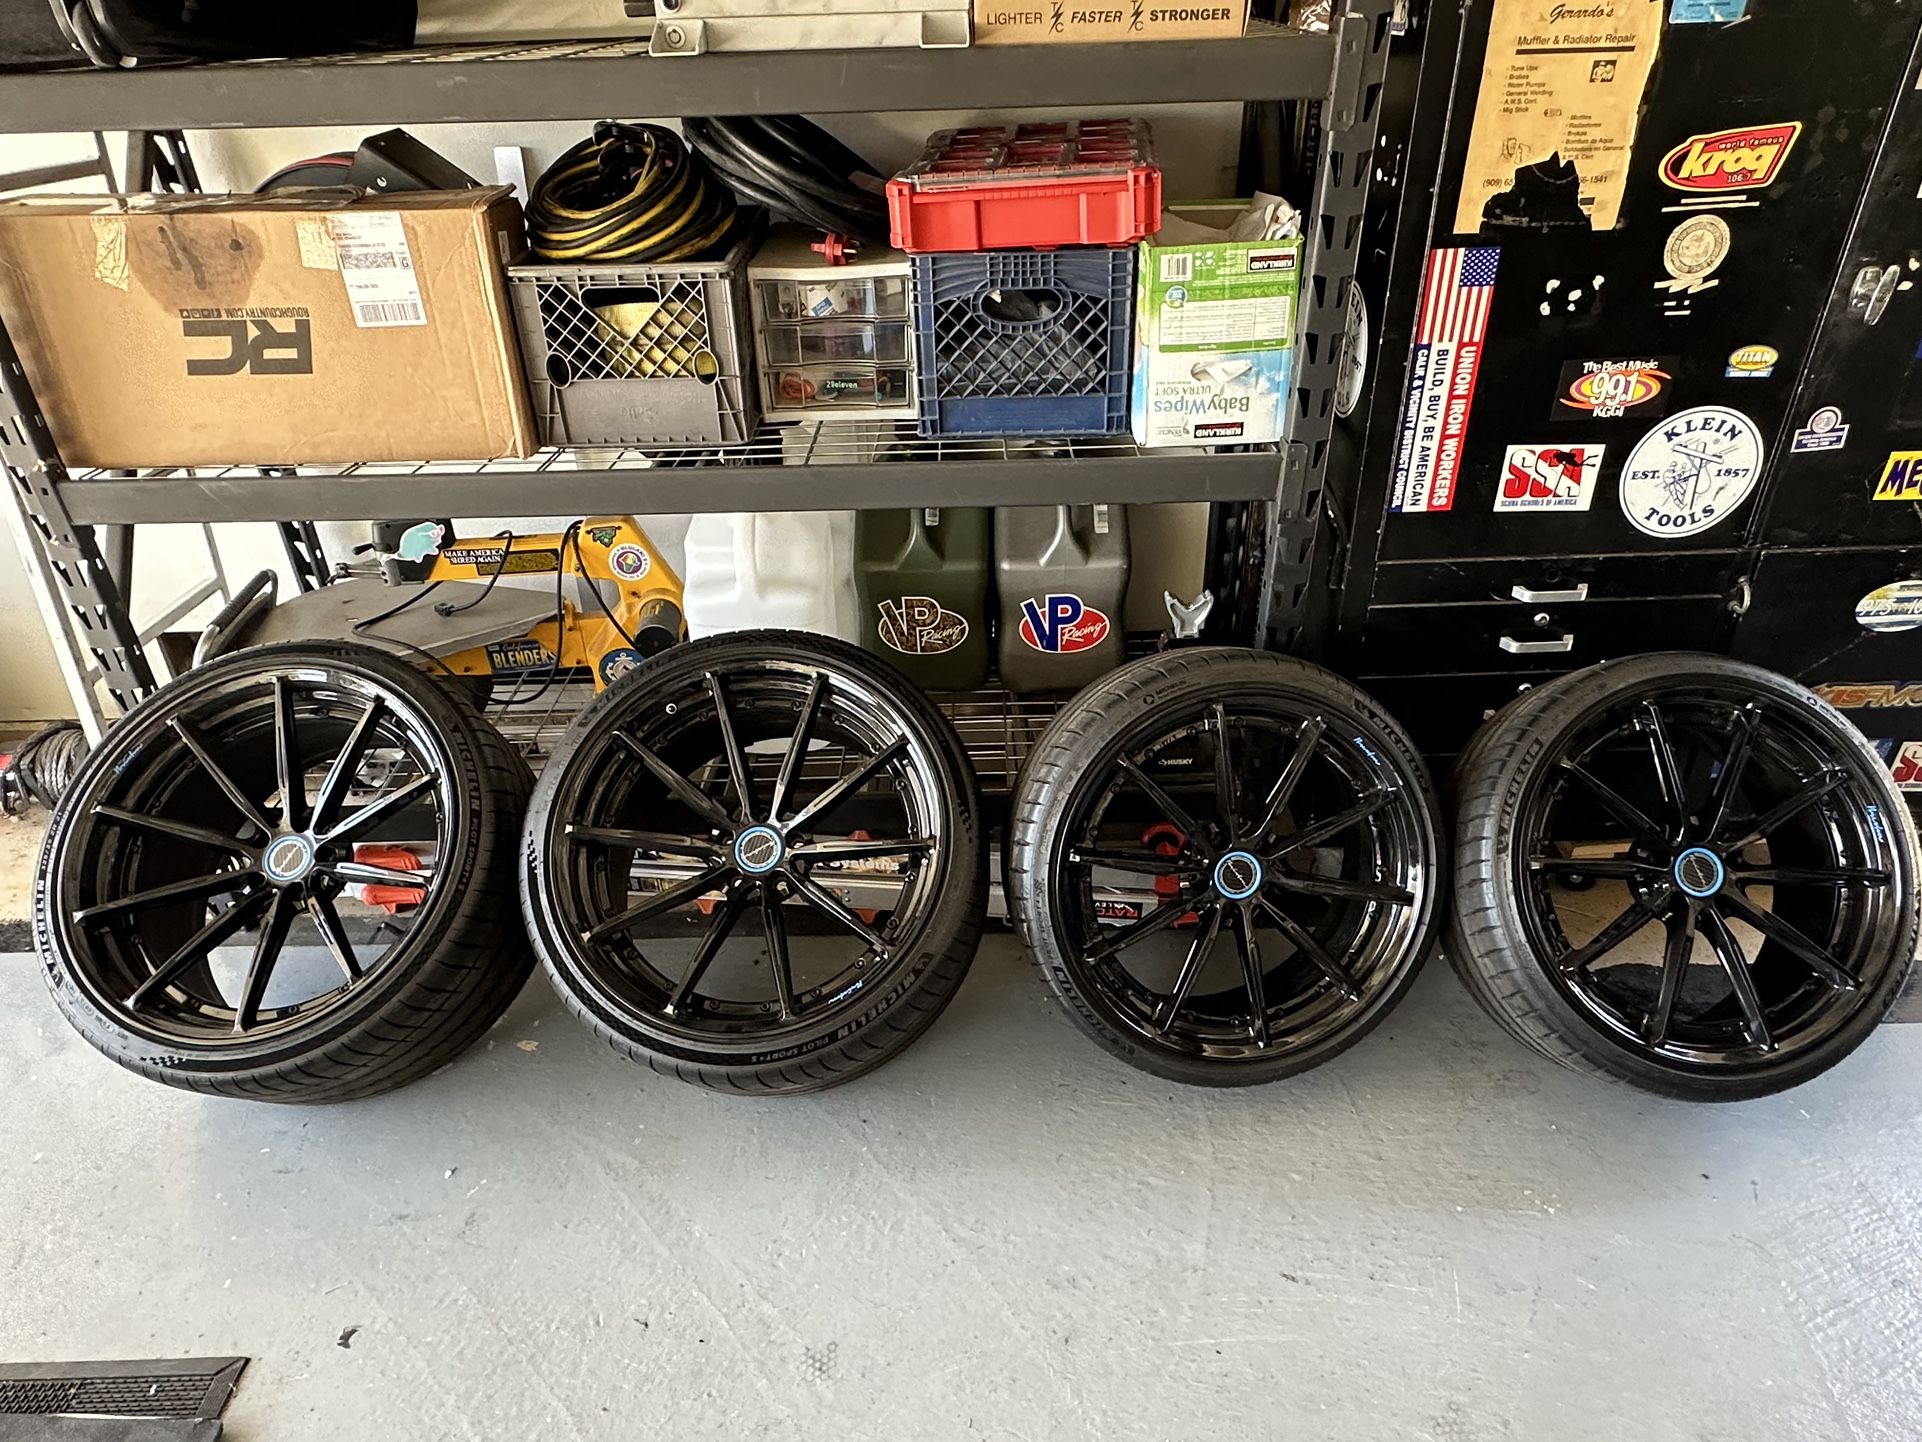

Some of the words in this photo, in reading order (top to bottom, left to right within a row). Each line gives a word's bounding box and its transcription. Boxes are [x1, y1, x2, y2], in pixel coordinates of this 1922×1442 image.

[986, 12, 1043, 25] LIGHTER
[1070, 10, 1123, 24] FASTER
[1149, 8, 1231, 22] STRONGER
[1549, 2, 1616, 25] Gerardo's
[1517, 35, 1551, 46] Muffler
[1552, 36, 1560, 44] &
[1562, 34, 1602, 44] Radiator
[1604, 33, 1637, 44] Repair
[1718, 140, 1745, 150] world
[1750, 136, 1784, 146] famous
[1482, 179, 1503, 188] (909)
[1250, 257, 1293, 270] KIRKLAND
[224, 306, 310, 318] ROUGHCOUNTRY.COM
[182, 319, 313, 375] RC
[1737, 352, 1771, 362] TITAN
[1427, 348, 1450, 391] BUILD,
[1453, 346, 1478, 396] UNION
[1582, 361, 1602, 374] The
[1602, 360, 1627, 373] Best
[1628, 358, 1658, 372] Music
[1154, 385, 1180, 396] SOFT
[1182, 385, 1212, 394] ULTRA
[1590, 372, 1639, 406] 99.1
[1406, 388, 1422, 429] VICINITY
[1421, 394, 1442, 422] BUY,
[1445, 398, 1468, 436] IRON
[1592, 406, 1625, 418] KGGI
[1195, 426, 1242, 438] KIRKLAND
[1421, 426, 1436, 442] BE
[1663, 417, 1743, 443] KLEIN
[1398, 430, 1414, 470] DISTRICT
[1409, 446, 1432, 507] AMERICAN
[1432, 438, 1459, 507] WORKERS
[1631, 470, 1660, 480] EST.
[1714, 468, 1750, 478] 1857
[1392, 470, 1407, 509] COUNCIL
[1644, 504, 1715, 528] TOOLS
[444, 550, 468, 558] MAKE
[470, 548, 504, 556] AMERICA
[450, 556, 476, 564] SHRED
[878, 596, 942, 654] VP
[920, 620, 967, 647] Racing
[1020, 594, 1084, 654] VP
[1062, 616, 1108, 644] Racing
[492, 648, 557, 669] BLENDERS
[1168, 758, 1193, 766] HUSKY
[35, 879, 55, 965] MICHELIN
[837, 972, 916, 1039] MICHELIN
[802, 1037, 830, 1052] PILOT
